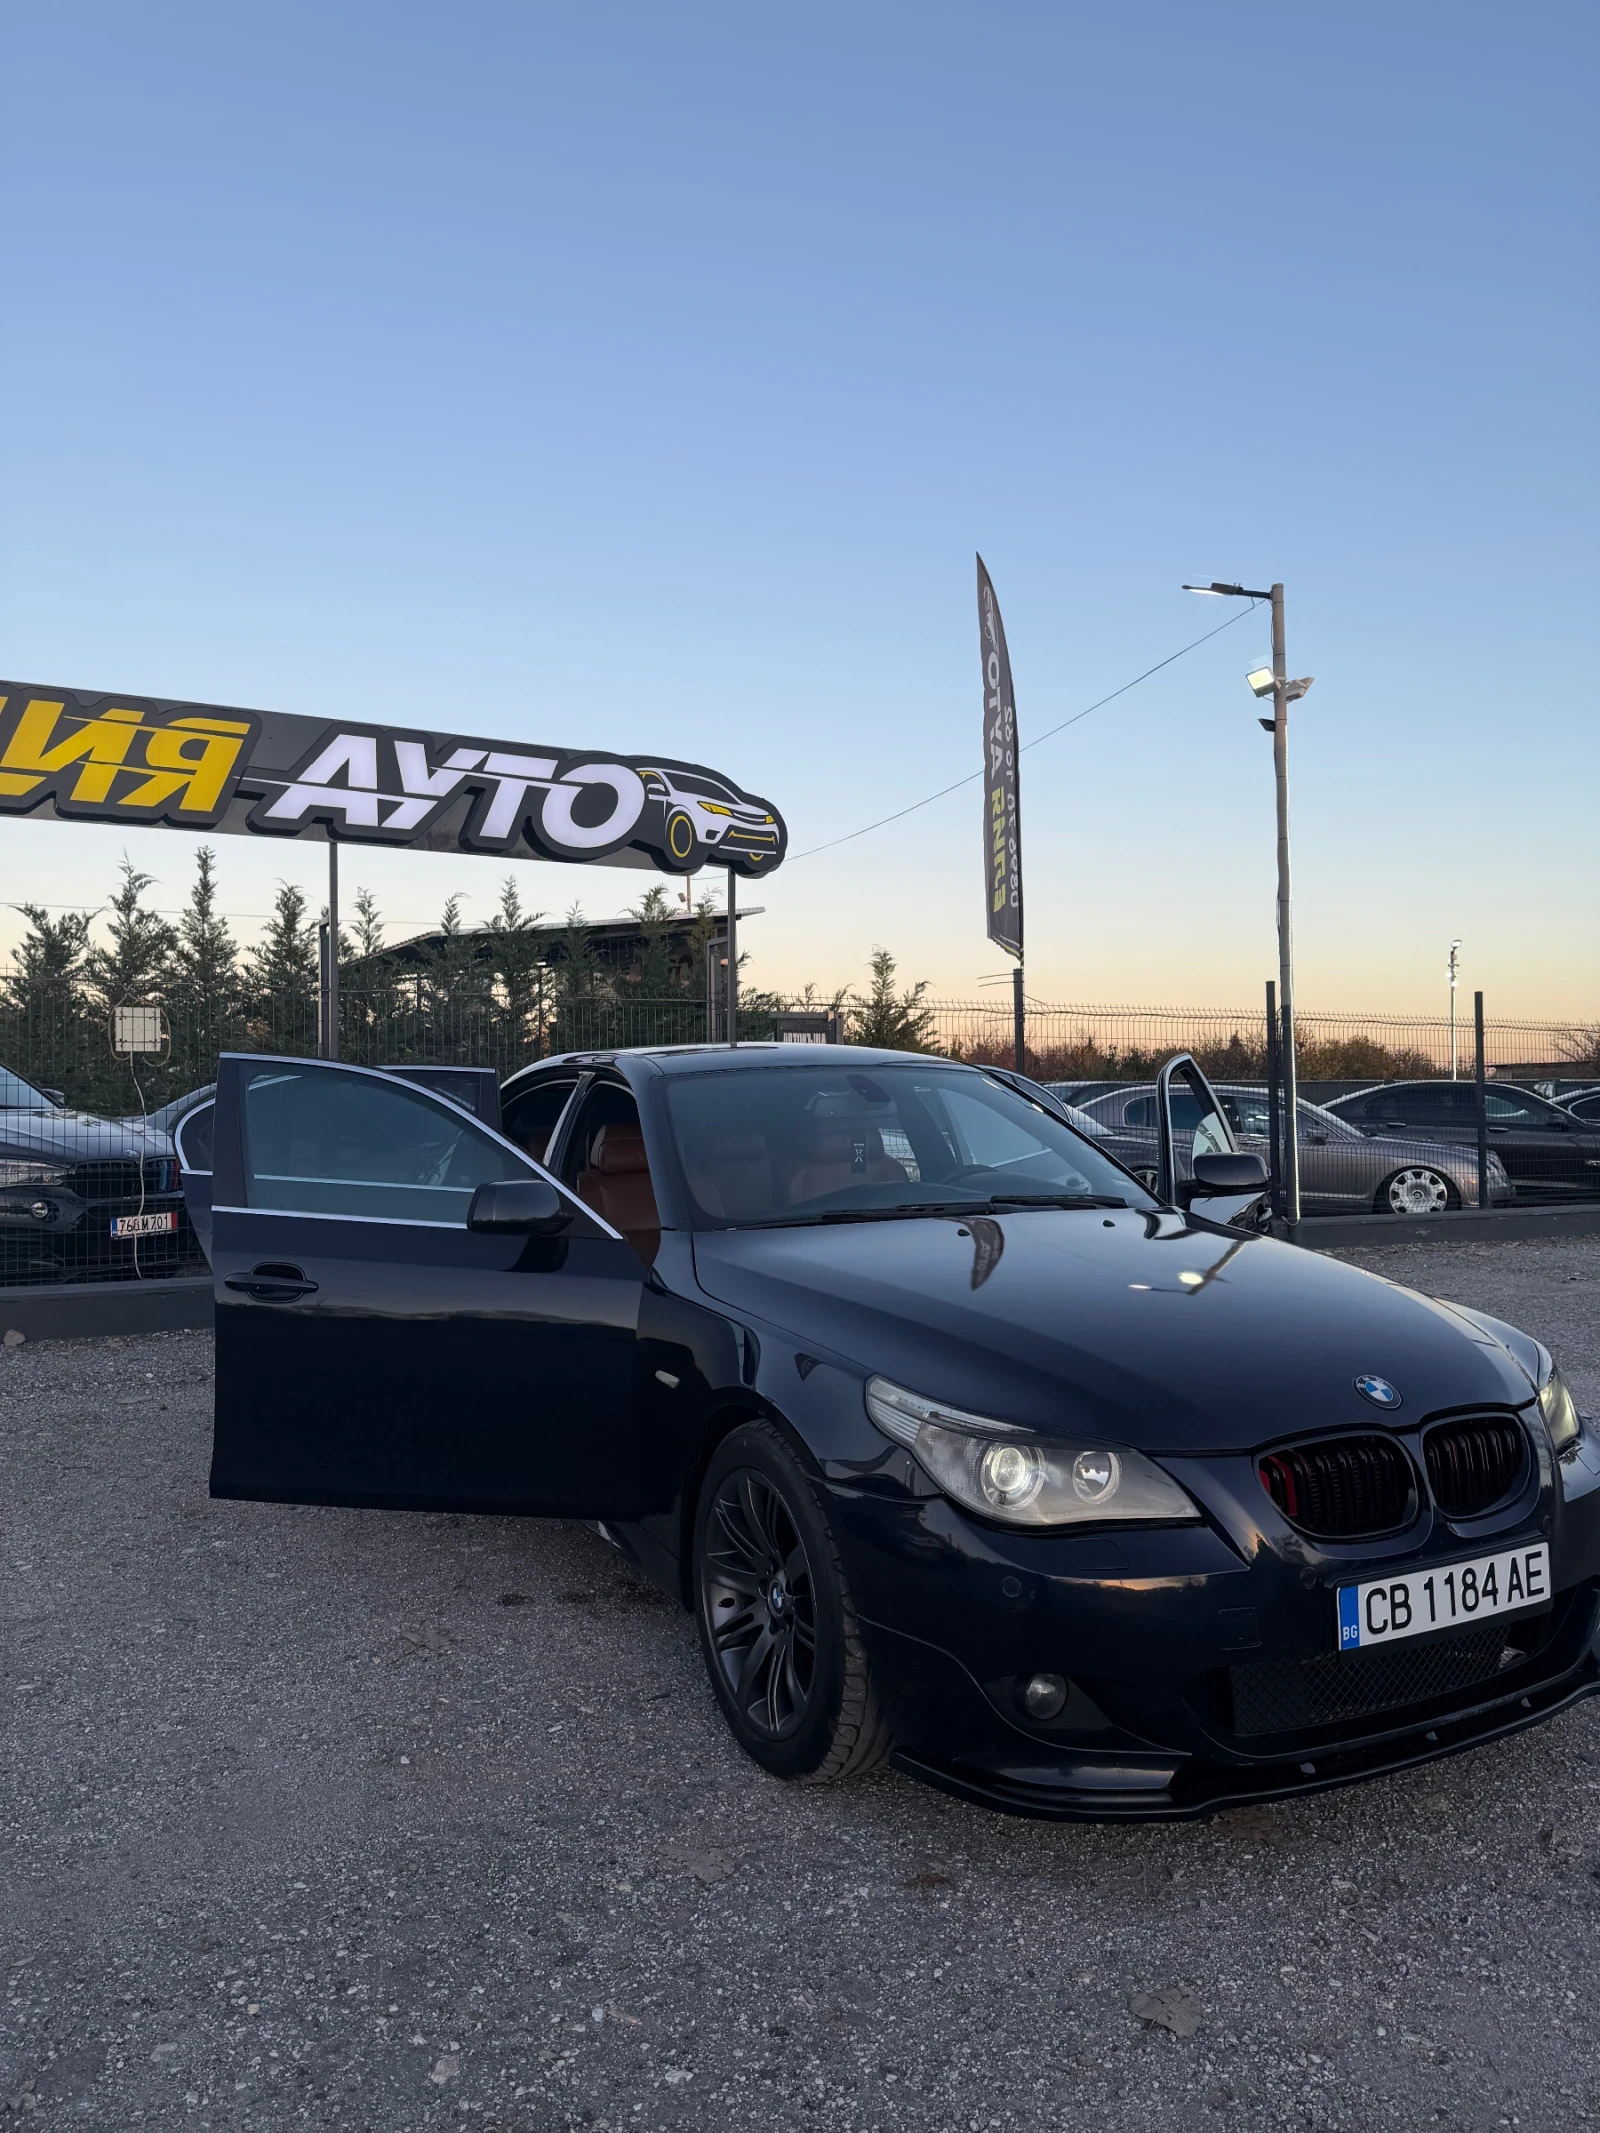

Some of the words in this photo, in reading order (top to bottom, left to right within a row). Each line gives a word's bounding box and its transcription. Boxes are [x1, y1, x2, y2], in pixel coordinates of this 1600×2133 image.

[0, 696, 251, 813] ИЯ
[263, 733, 645, 849] АУТО
[1343, 1624, 1358, 1641] BG
[1365, 1582, 1413, 1635] CB
[1423, 1561, 1499, 1622] 1184
[1507, 1550, 1545, 1604] AE
